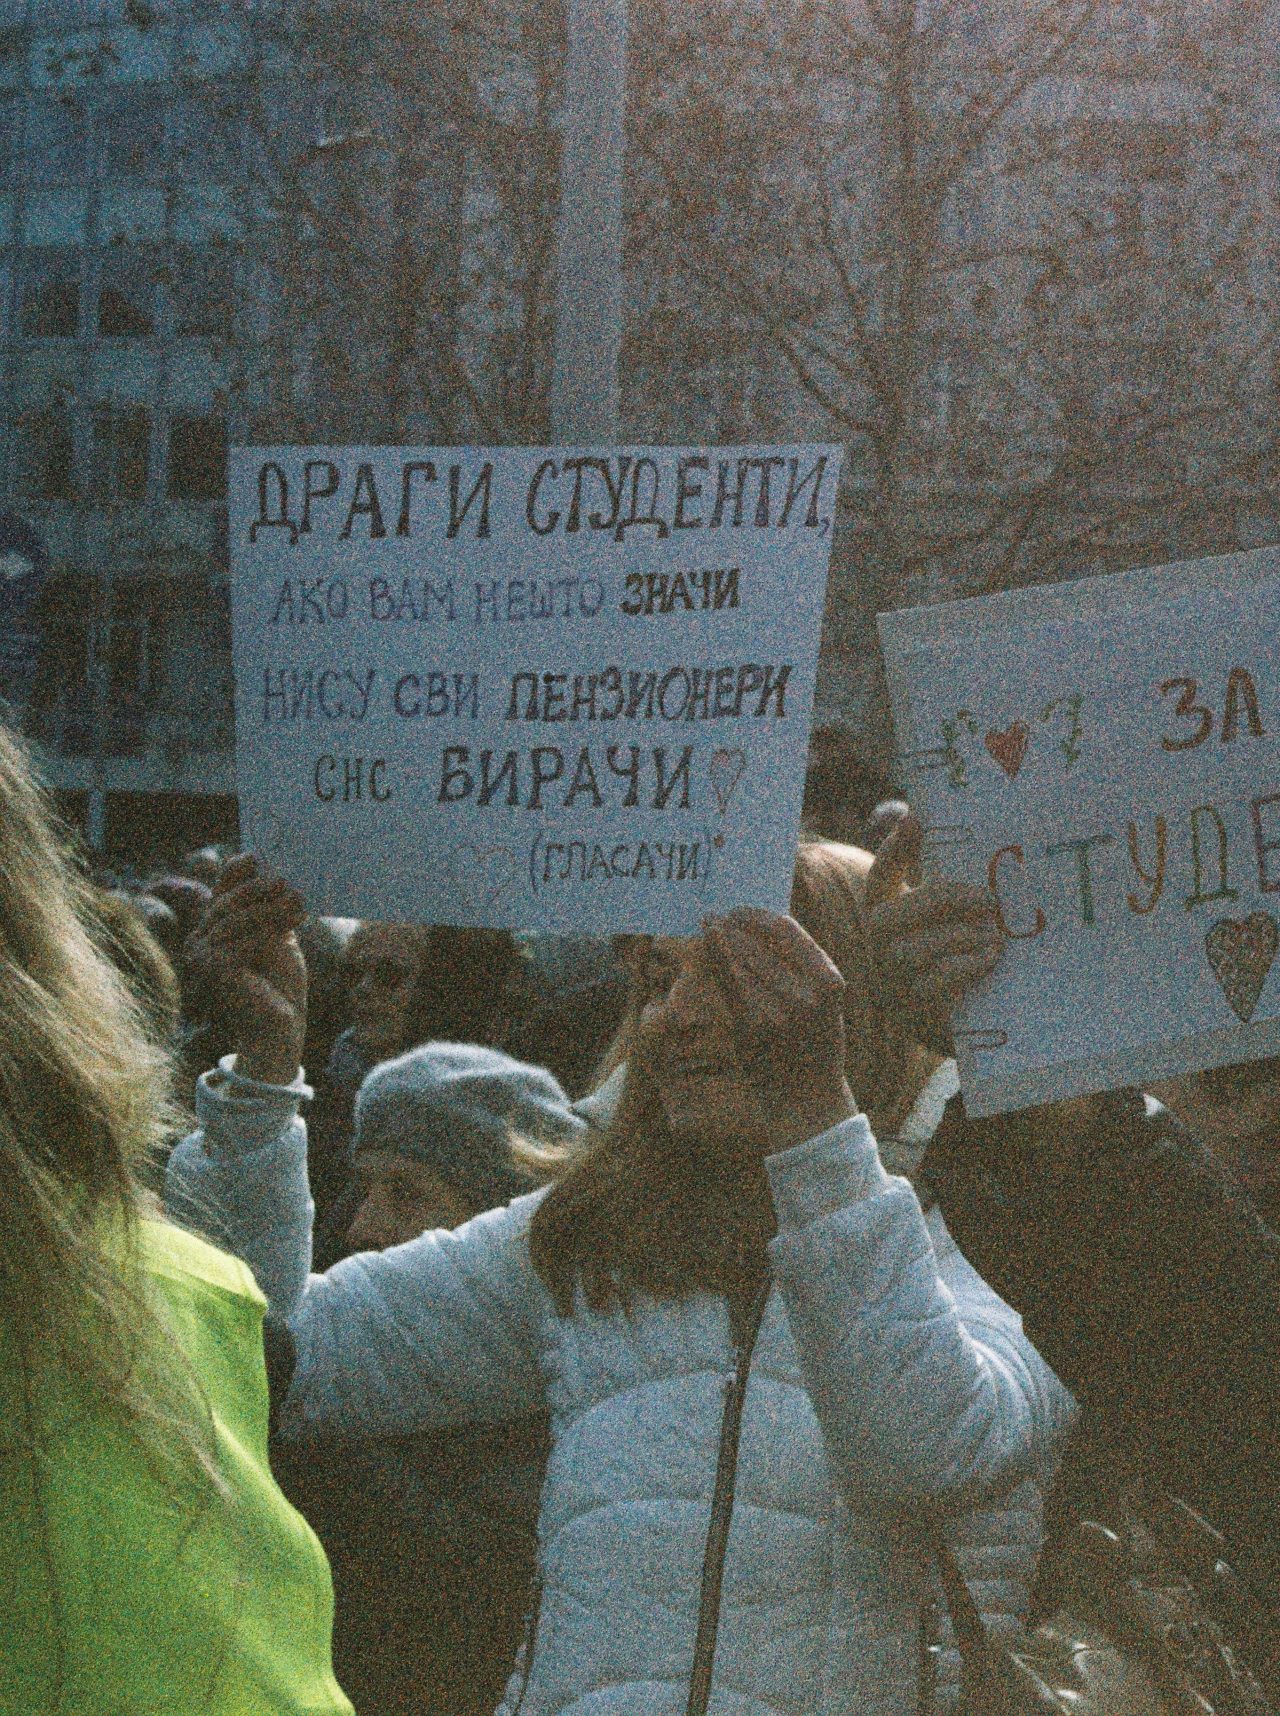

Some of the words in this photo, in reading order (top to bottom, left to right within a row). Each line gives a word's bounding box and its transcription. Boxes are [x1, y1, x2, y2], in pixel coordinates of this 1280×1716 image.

[251, 460, 493, 545] ДРАГИ
[526, 455, 831, 541] СТУДЕНТИ,
[269, 577, 348, 624] АКО
[369, 578, 456, 622] ВАМ
[474, 577, 606, 623] НЕШТО
[620, 568, 742, 616] ЗНАЧИ
[263, 669, 376, 720] НИСУ
[394, 672, 480, 719] СВИ
[505, 664, 793, 722] ПЕНЗИОНЕРИ
[1160, 667, 1264, 751] ЗА
[314, 754, 392, 802] СНС
[437, 745, 691, 809] БИРАЧИ
